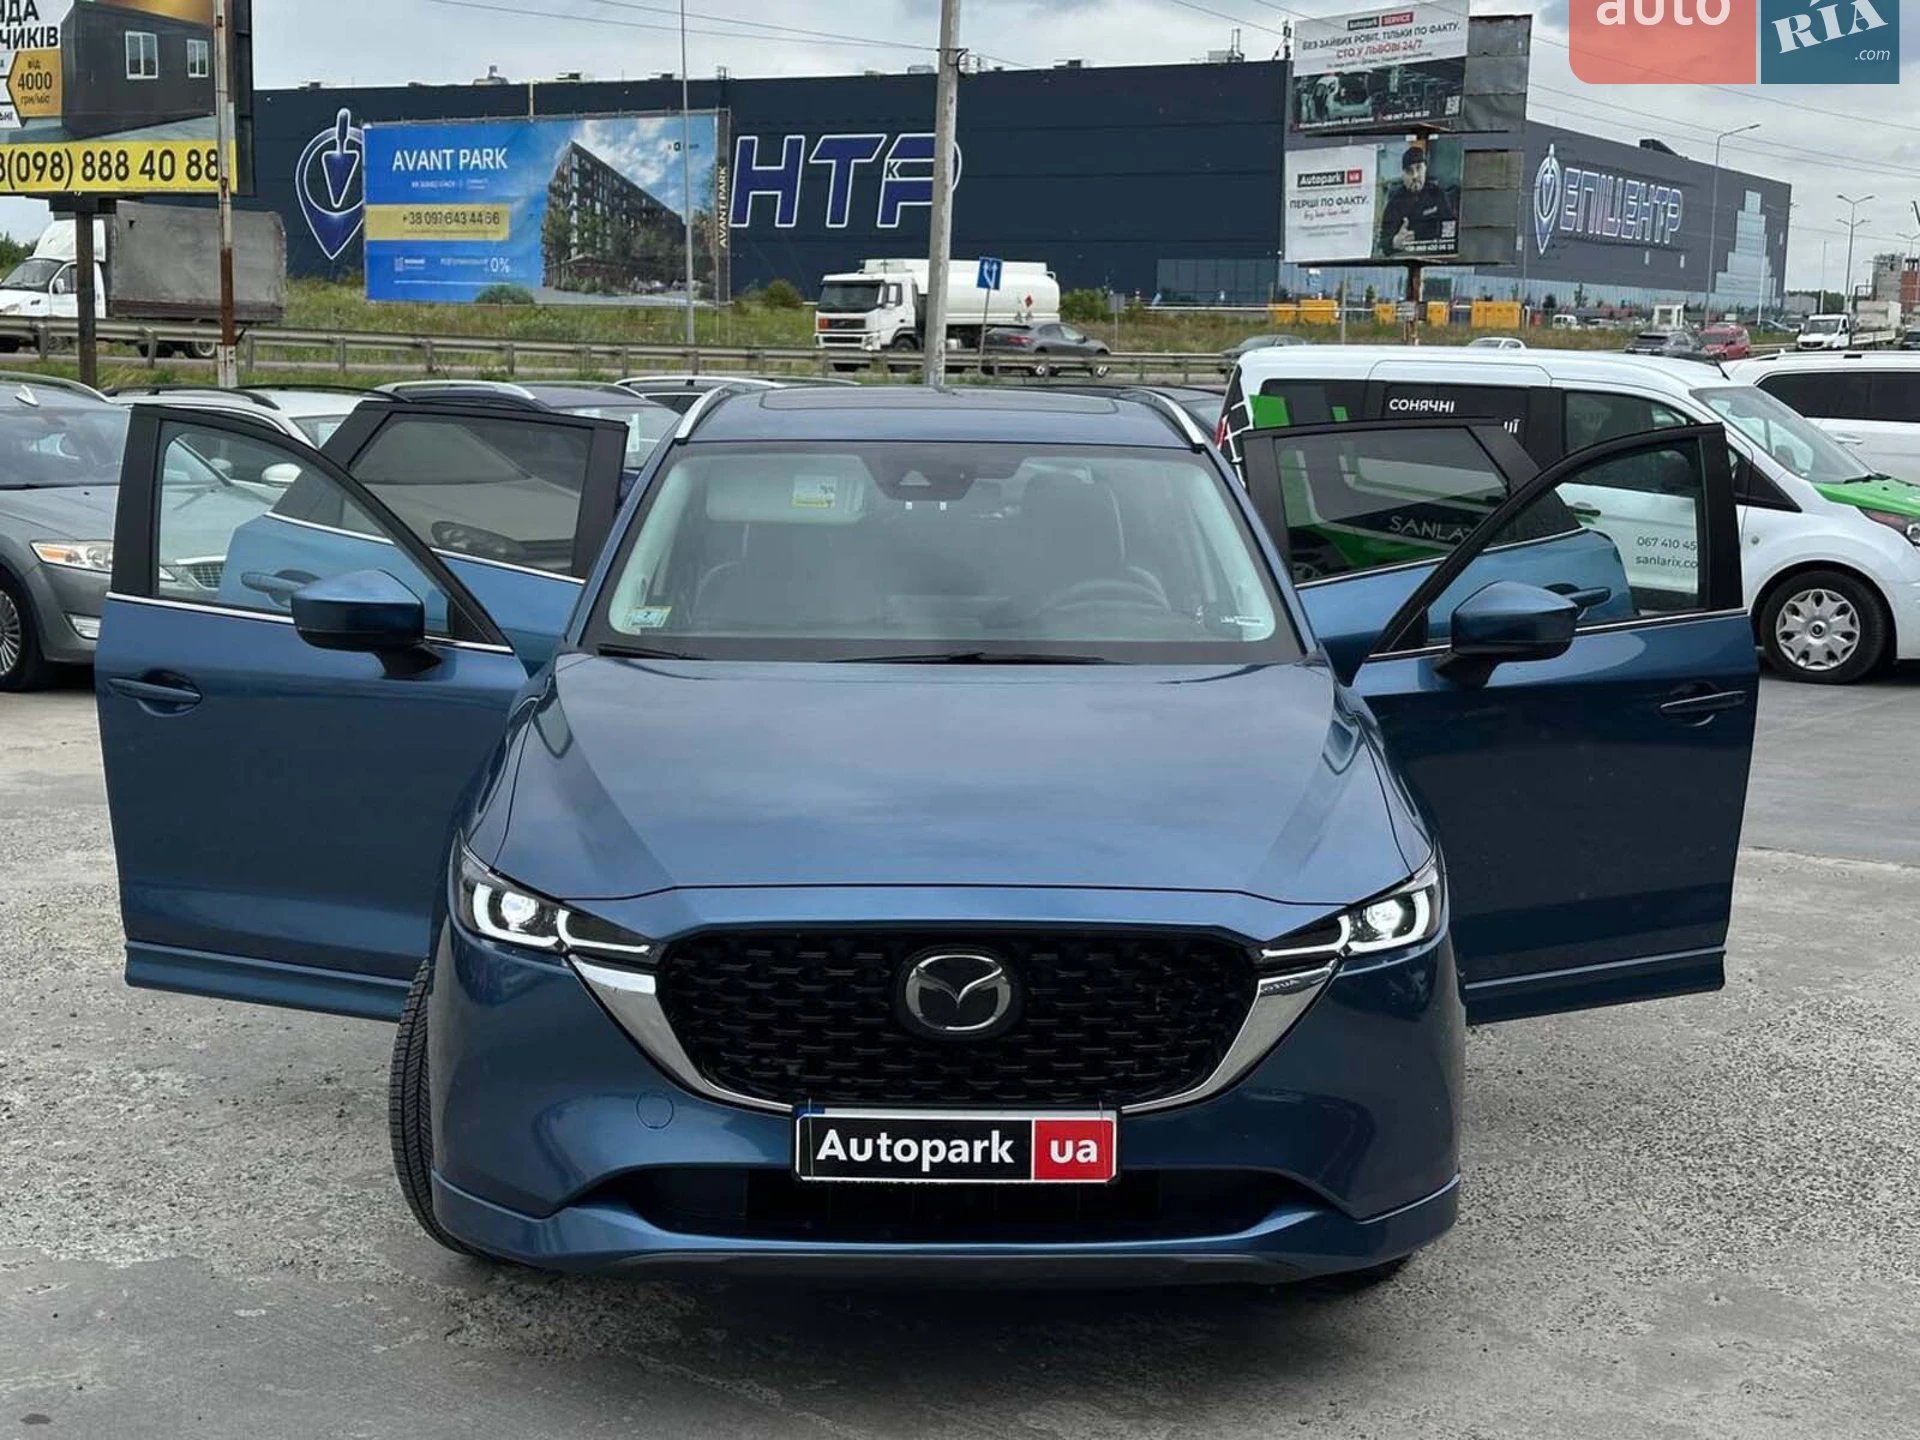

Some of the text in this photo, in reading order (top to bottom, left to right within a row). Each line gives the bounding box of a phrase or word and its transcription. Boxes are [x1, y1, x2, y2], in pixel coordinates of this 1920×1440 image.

[1302, 40, 1318, 50] БЕЗ
[1414, 26, 1428, 36] ПО
[1336, 39, 1423, 59] СТО У ЛЬВОВІ 24/7
[17, 71, 53, 91] 4000
[81, 149, 129, 182] 888
[139, 149, 176, 182] 40
[185, 148, 218, 181] 88
[392, 147, 508, 172] AVANT PARK
[1299, 173, 1342, 186] Autopark
[718, 166, 728, 248] AVANT PARK
[1289, 198, 1319, 209] ПЕРШІ
[1321, 197, 1334, 208] ПО
[1560, 167, 1682, 245] ЕПІЦЕНТР
[402, 212, 422, 225] +38
[469, 212, 483, 225] 44
[490, 256, 511, 273] 0%
[1388, 396, 1455, 413] СОНЯЧНІ
[1636, 536, 1698, 551] 067 410 45
[816, 1129, 1098, 1172] Autopark ua
